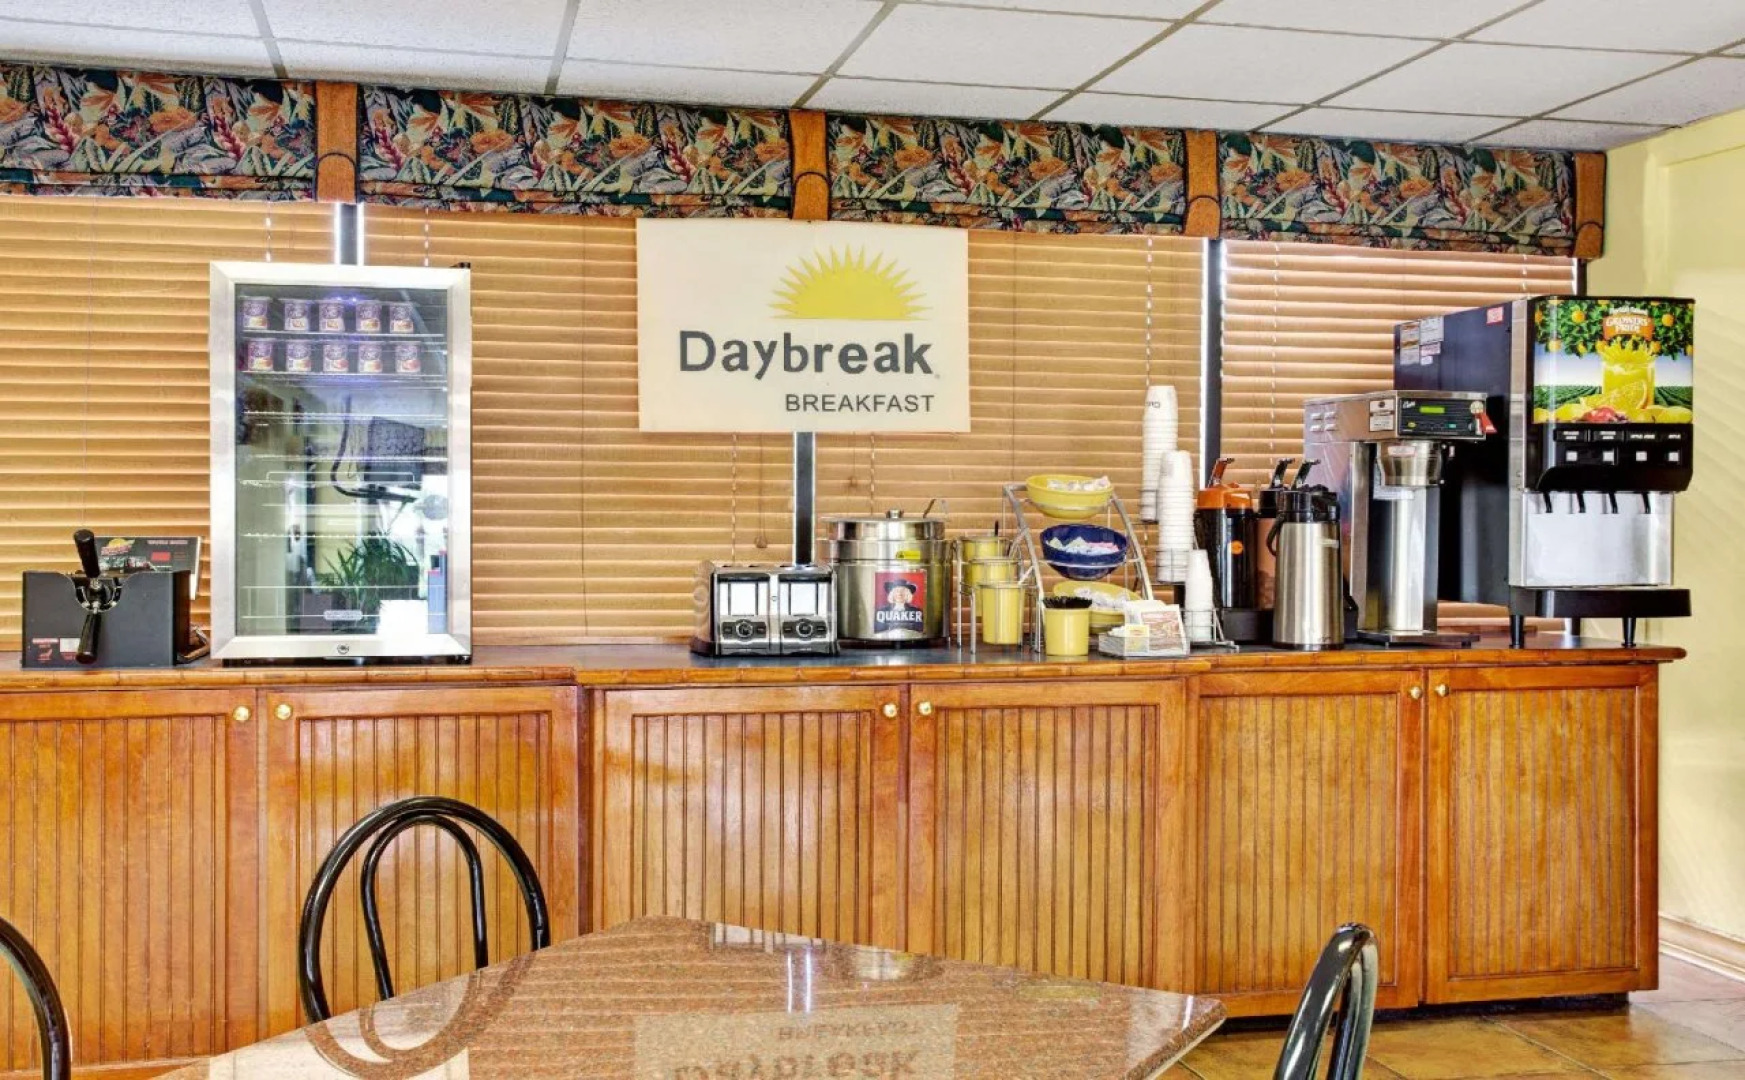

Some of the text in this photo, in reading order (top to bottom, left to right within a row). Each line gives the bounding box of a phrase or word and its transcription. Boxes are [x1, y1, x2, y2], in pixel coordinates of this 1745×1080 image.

[680, 331, 932, 379] Daybreak
[786, 395, 934, 412] BREAKFAST
[877, 610, 923, 623] QUAKER
